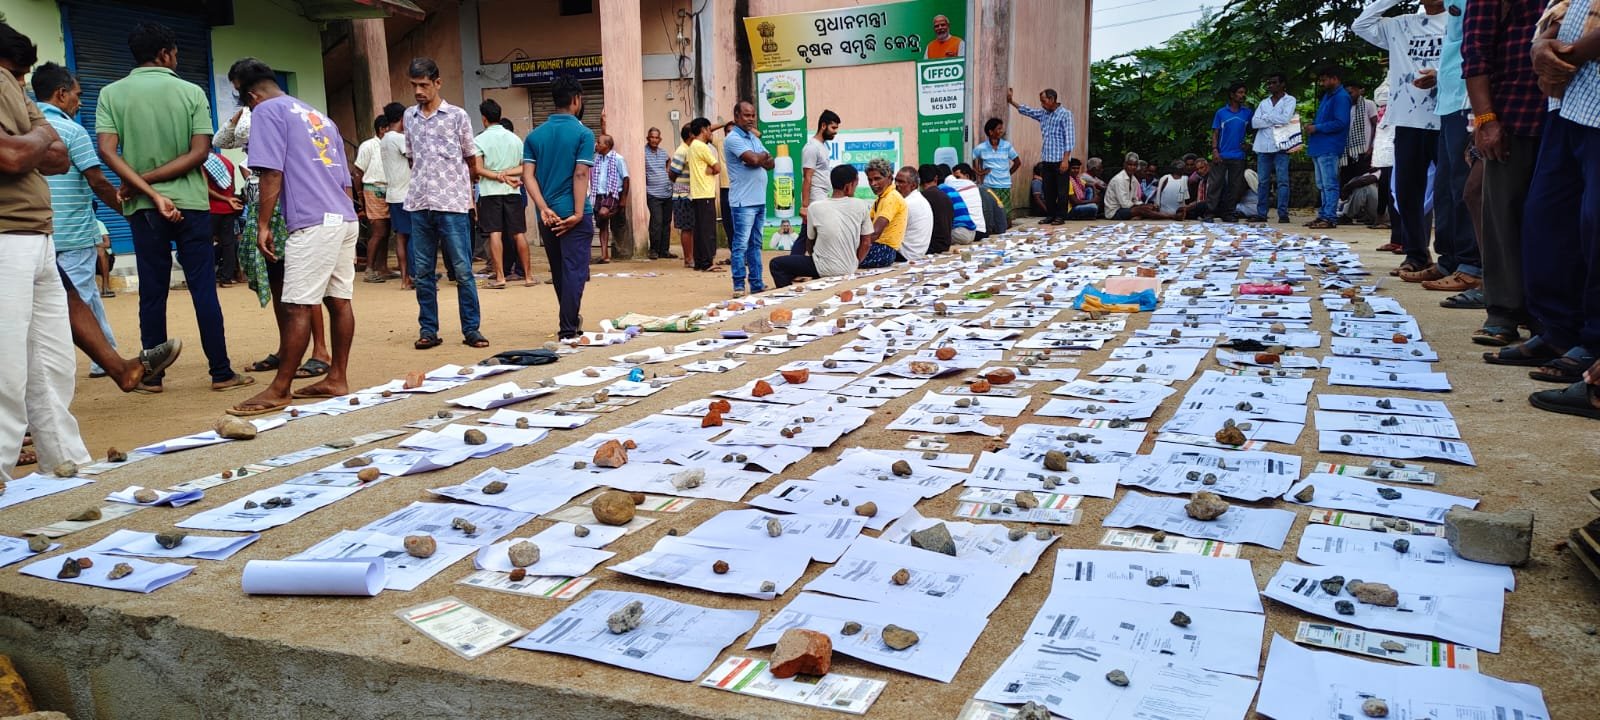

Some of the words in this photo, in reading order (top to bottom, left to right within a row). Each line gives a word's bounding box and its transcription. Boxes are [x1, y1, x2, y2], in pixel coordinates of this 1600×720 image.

[814, 11, 887, 36] ପ୍ରଧାନମନ୍ତ୍ରୀ
[797, 43, 833, 64] କୃଷକ
[840, 34, 877, 60] ସମୃଦ୍ଧି
[884, 33, 921, 53] କେନ୍ଦ୍ର
[536, 59, 564, 71] PRIMARY
[928, 66, 959, 79] IFFCO
[930, 95, 957, 103] BAGADIA
